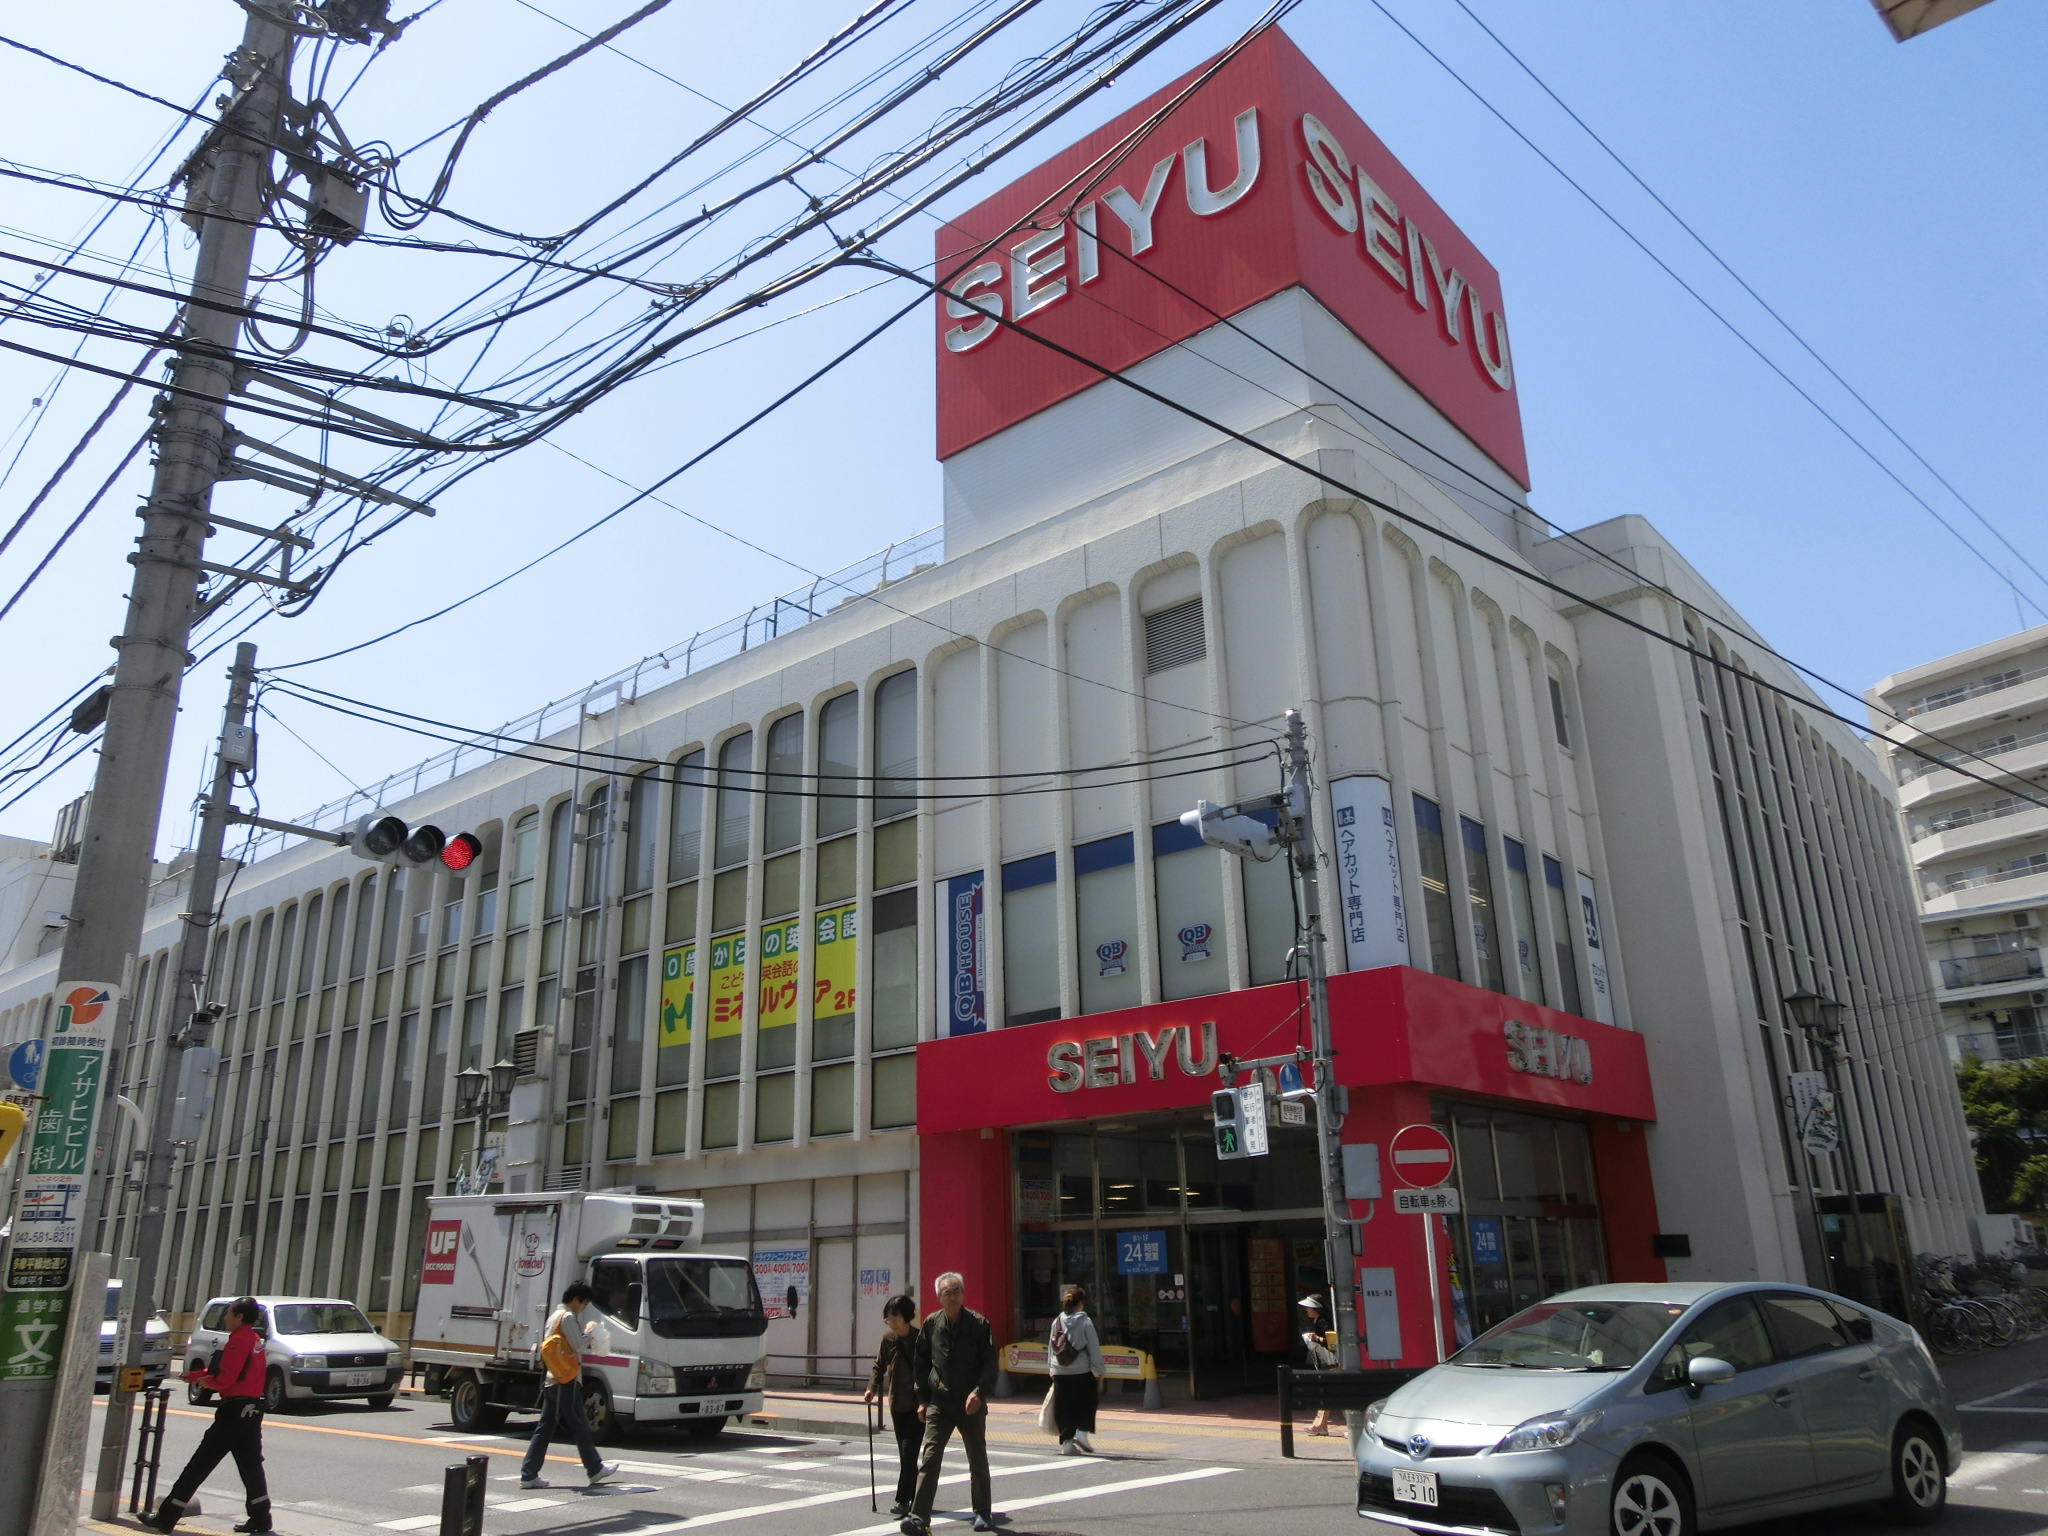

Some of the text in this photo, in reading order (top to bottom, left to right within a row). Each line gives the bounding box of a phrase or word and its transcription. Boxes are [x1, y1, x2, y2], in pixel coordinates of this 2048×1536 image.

[945, 106, 1260, 353] SEIYU
[1302, 112, 1511, 390] SEIYU
[1341, 829, 1365, 944] ヘアカット専門店
[1385, 829, 1405, 944] ヘアカット専門店
[1101, 942, 1121, 958] QB
[1184, 925, 1205, 943] QB
[955, 891, 975, 1021] QB HOUSE
[1048, 1022, 1216, 1093] SEIYU
[1504, 1020, 1593, 1084] SEIYU
[57, 1055, 99, 1170] アサヒビル
[32, 1109, 65, 1170] 歯科
[1399, 1193, 1455, 1209] 自転車を除く
[430, 1231, 456, 1255] UF
[1124, 1243, 1142, 1262] 24
[1475, 1231, 1488, 1250] 24
[425, 1262, 456, 1271] UCC FOODS
[773, 1263, 786, 1273] 400
[792, 1262, 805, 1273] 700
[16, 1299, 64, 1313] 通学路
[8, 1318, 58, 1364] 文
[683, 1364, 744, 1372] CANTER
